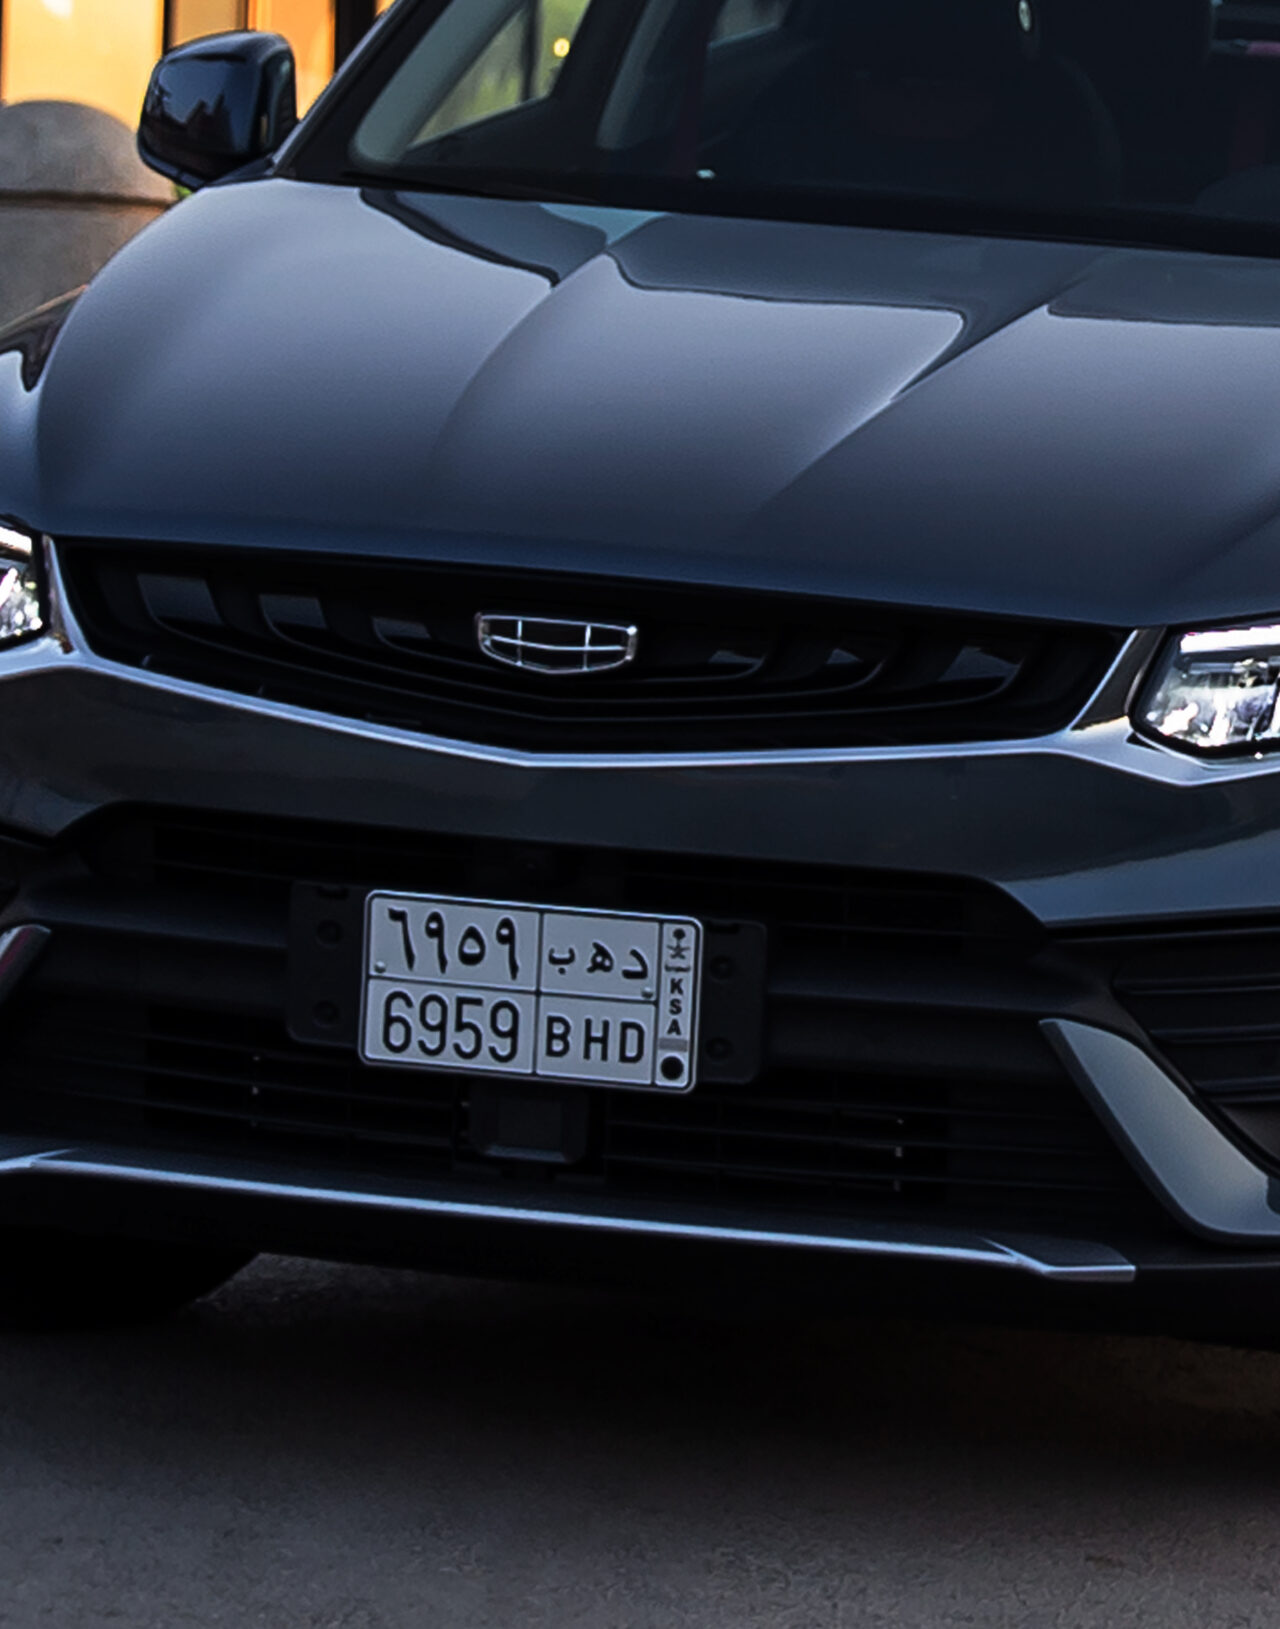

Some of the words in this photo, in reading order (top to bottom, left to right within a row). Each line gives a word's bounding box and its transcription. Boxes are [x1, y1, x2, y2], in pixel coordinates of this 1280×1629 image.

[382, 990, 520, 1064] 6959
[666, 978, 684, 1036] KSA
[546, 1015, 646, 1064] BHD
